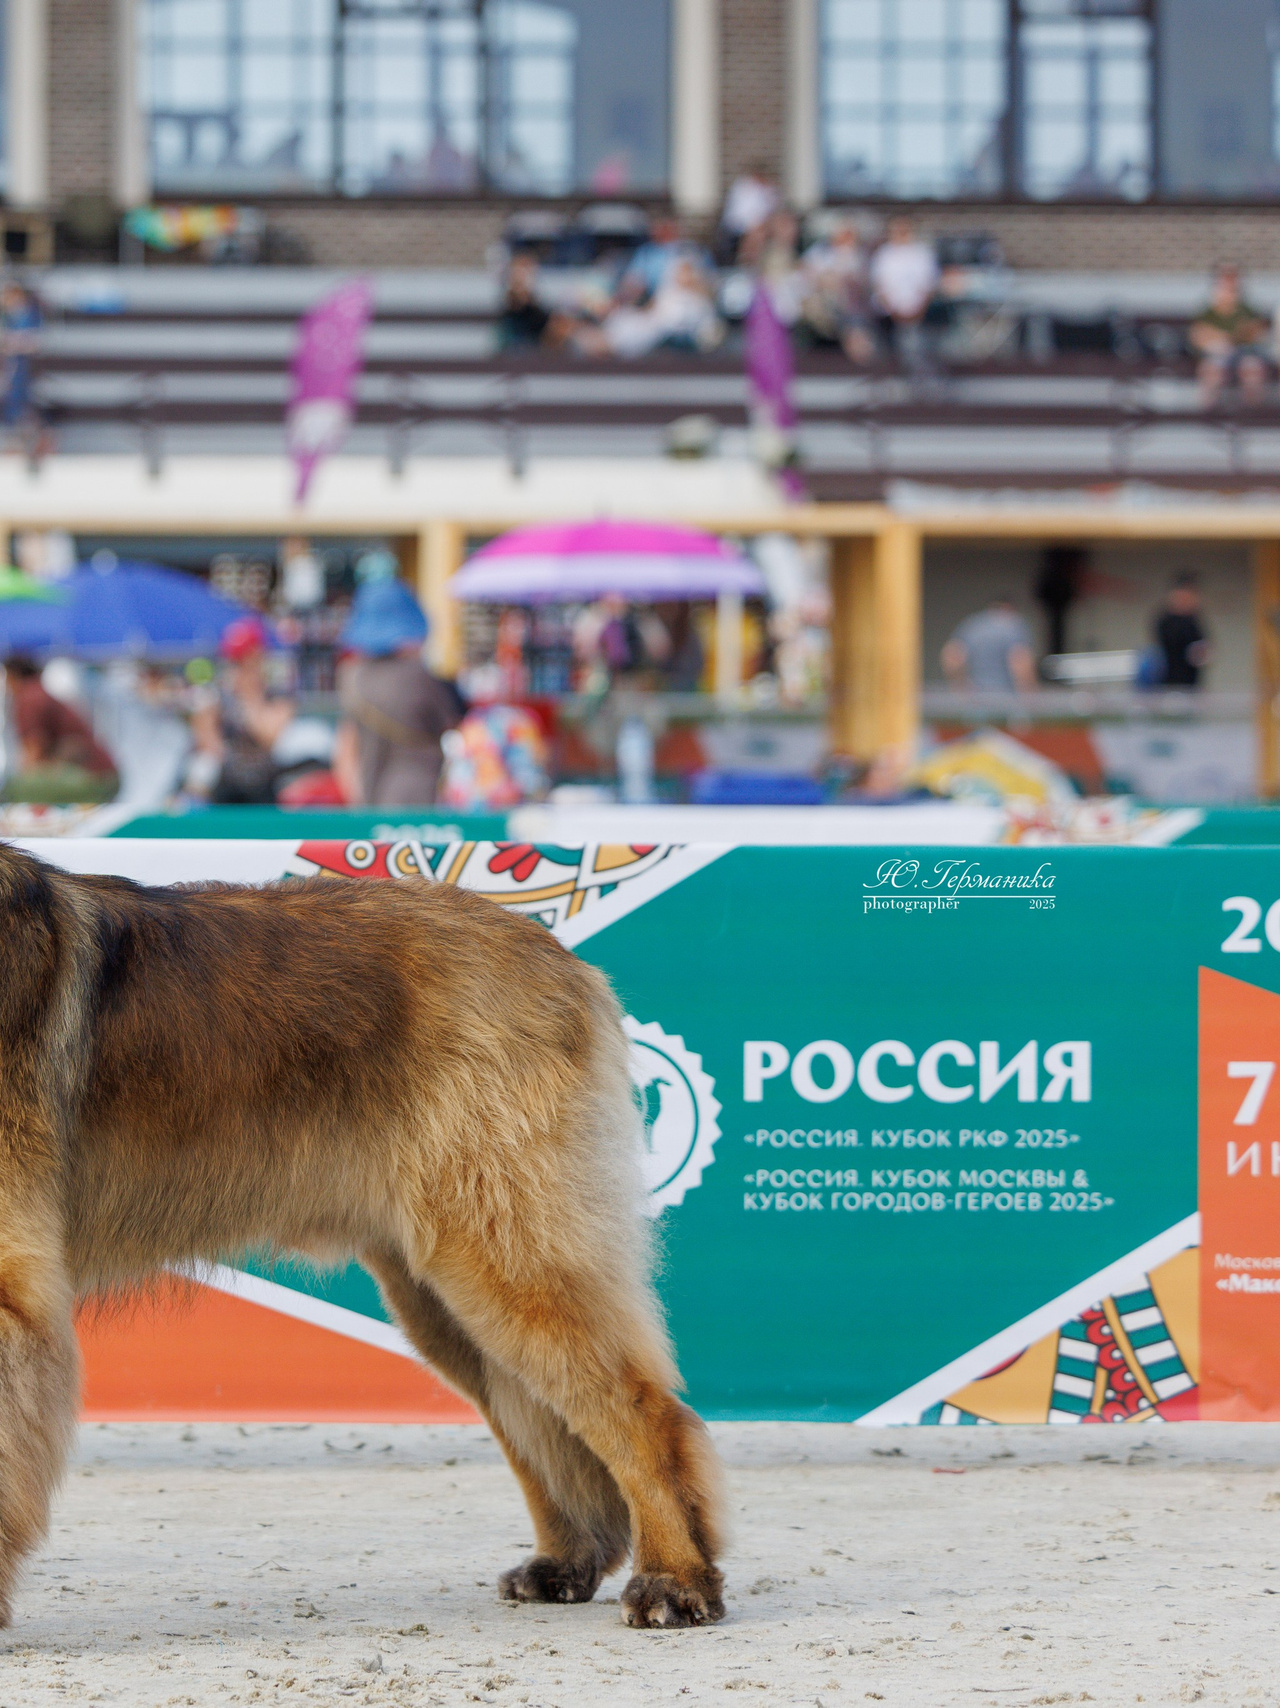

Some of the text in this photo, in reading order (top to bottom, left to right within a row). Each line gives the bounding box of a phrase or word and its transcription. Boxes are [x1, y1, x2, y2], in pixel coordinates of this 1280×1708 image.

[743, 1039, 1092, 1104] РОССИЯ
[1227, 1060, 1276, 1126] 7
[743, 1128, 1080, 1149] «РОССИЯ. КУБОК РКФ 2025»
[1226, 1140, 1280, 1177] И
[743, 1168, 1089, 1189] «РОССИЯ. КУБОК МОСКВЫ &
[743, 1191, 1114, 1213] КУБОК ГОРОДОВ-ГЕРОЕВ 2025»
